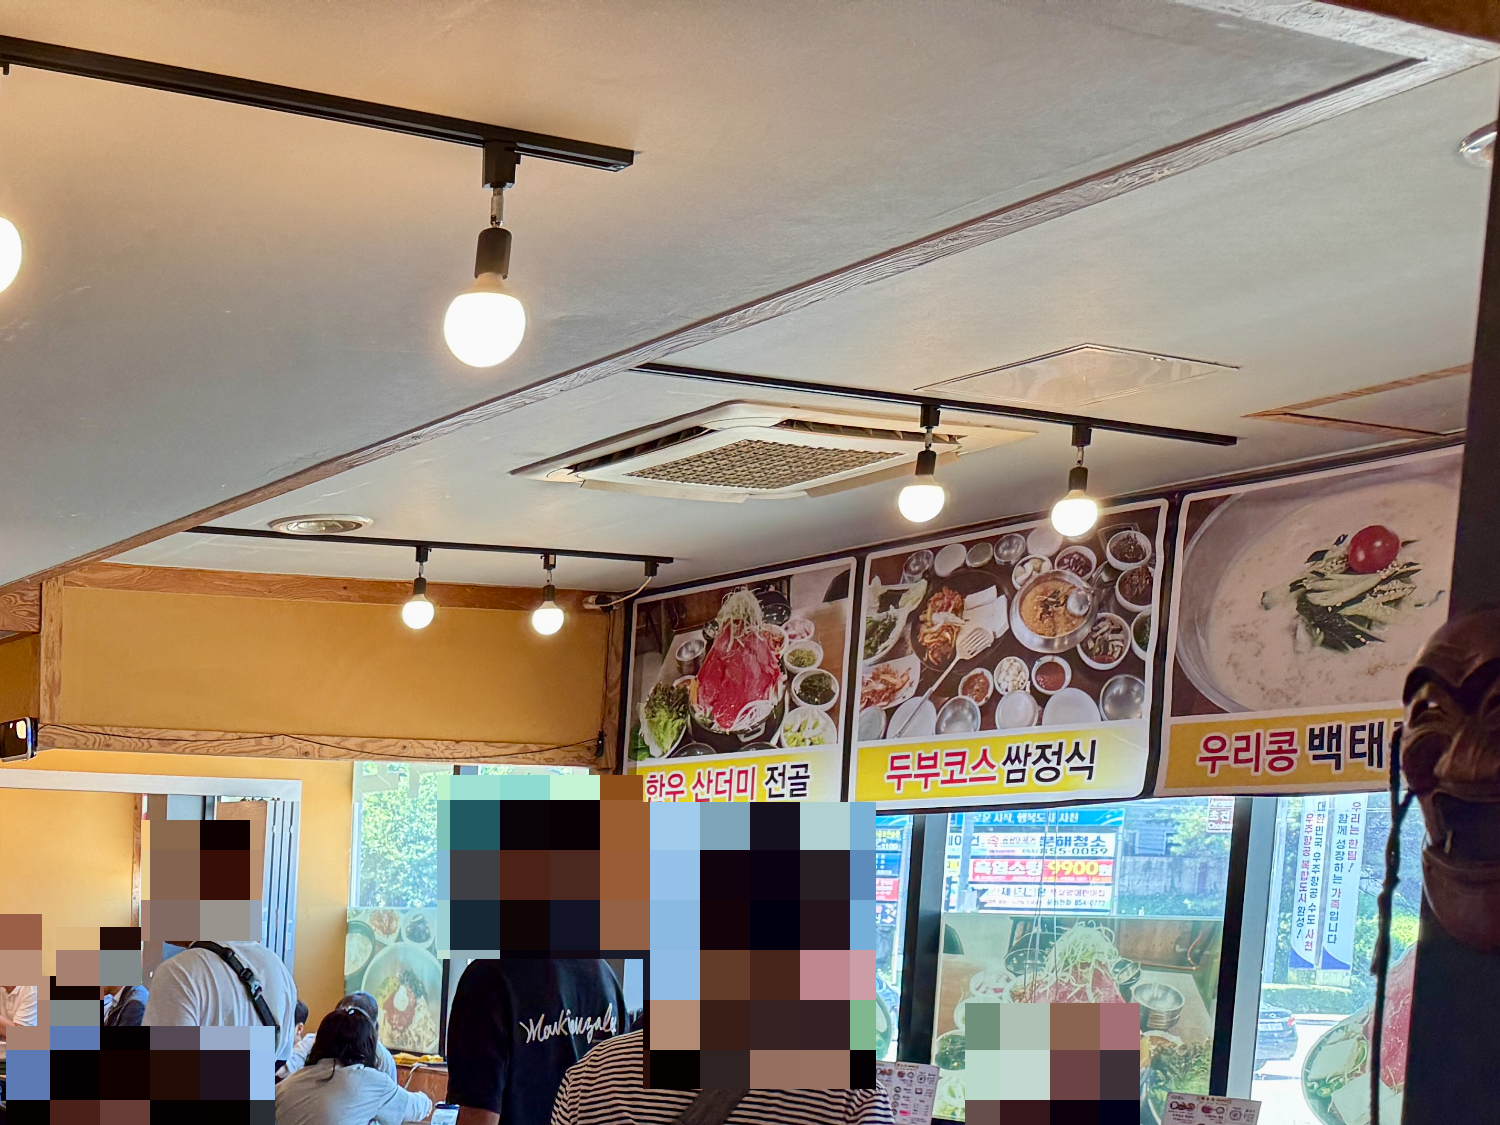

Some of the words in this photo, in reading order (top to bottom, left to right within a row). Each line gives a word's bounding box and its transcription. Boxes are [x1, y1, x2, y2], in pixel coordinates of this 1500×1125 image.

[886, 748, 996, 791] 두부코스
[1002, 739, 1097, 784] 쌈정식
[1199, 731, 1298, 774] 우리콩
[1308, 721, 1403, 770] 백태
[692, 766, 756, 802] 산더미
[765, 763, 811, 799] 전골
[1350, 802, 1361, 835] 우리는
[1333, 839, 1345, 884] 성장하는
[1307, 903, 1316, 924] 수도
